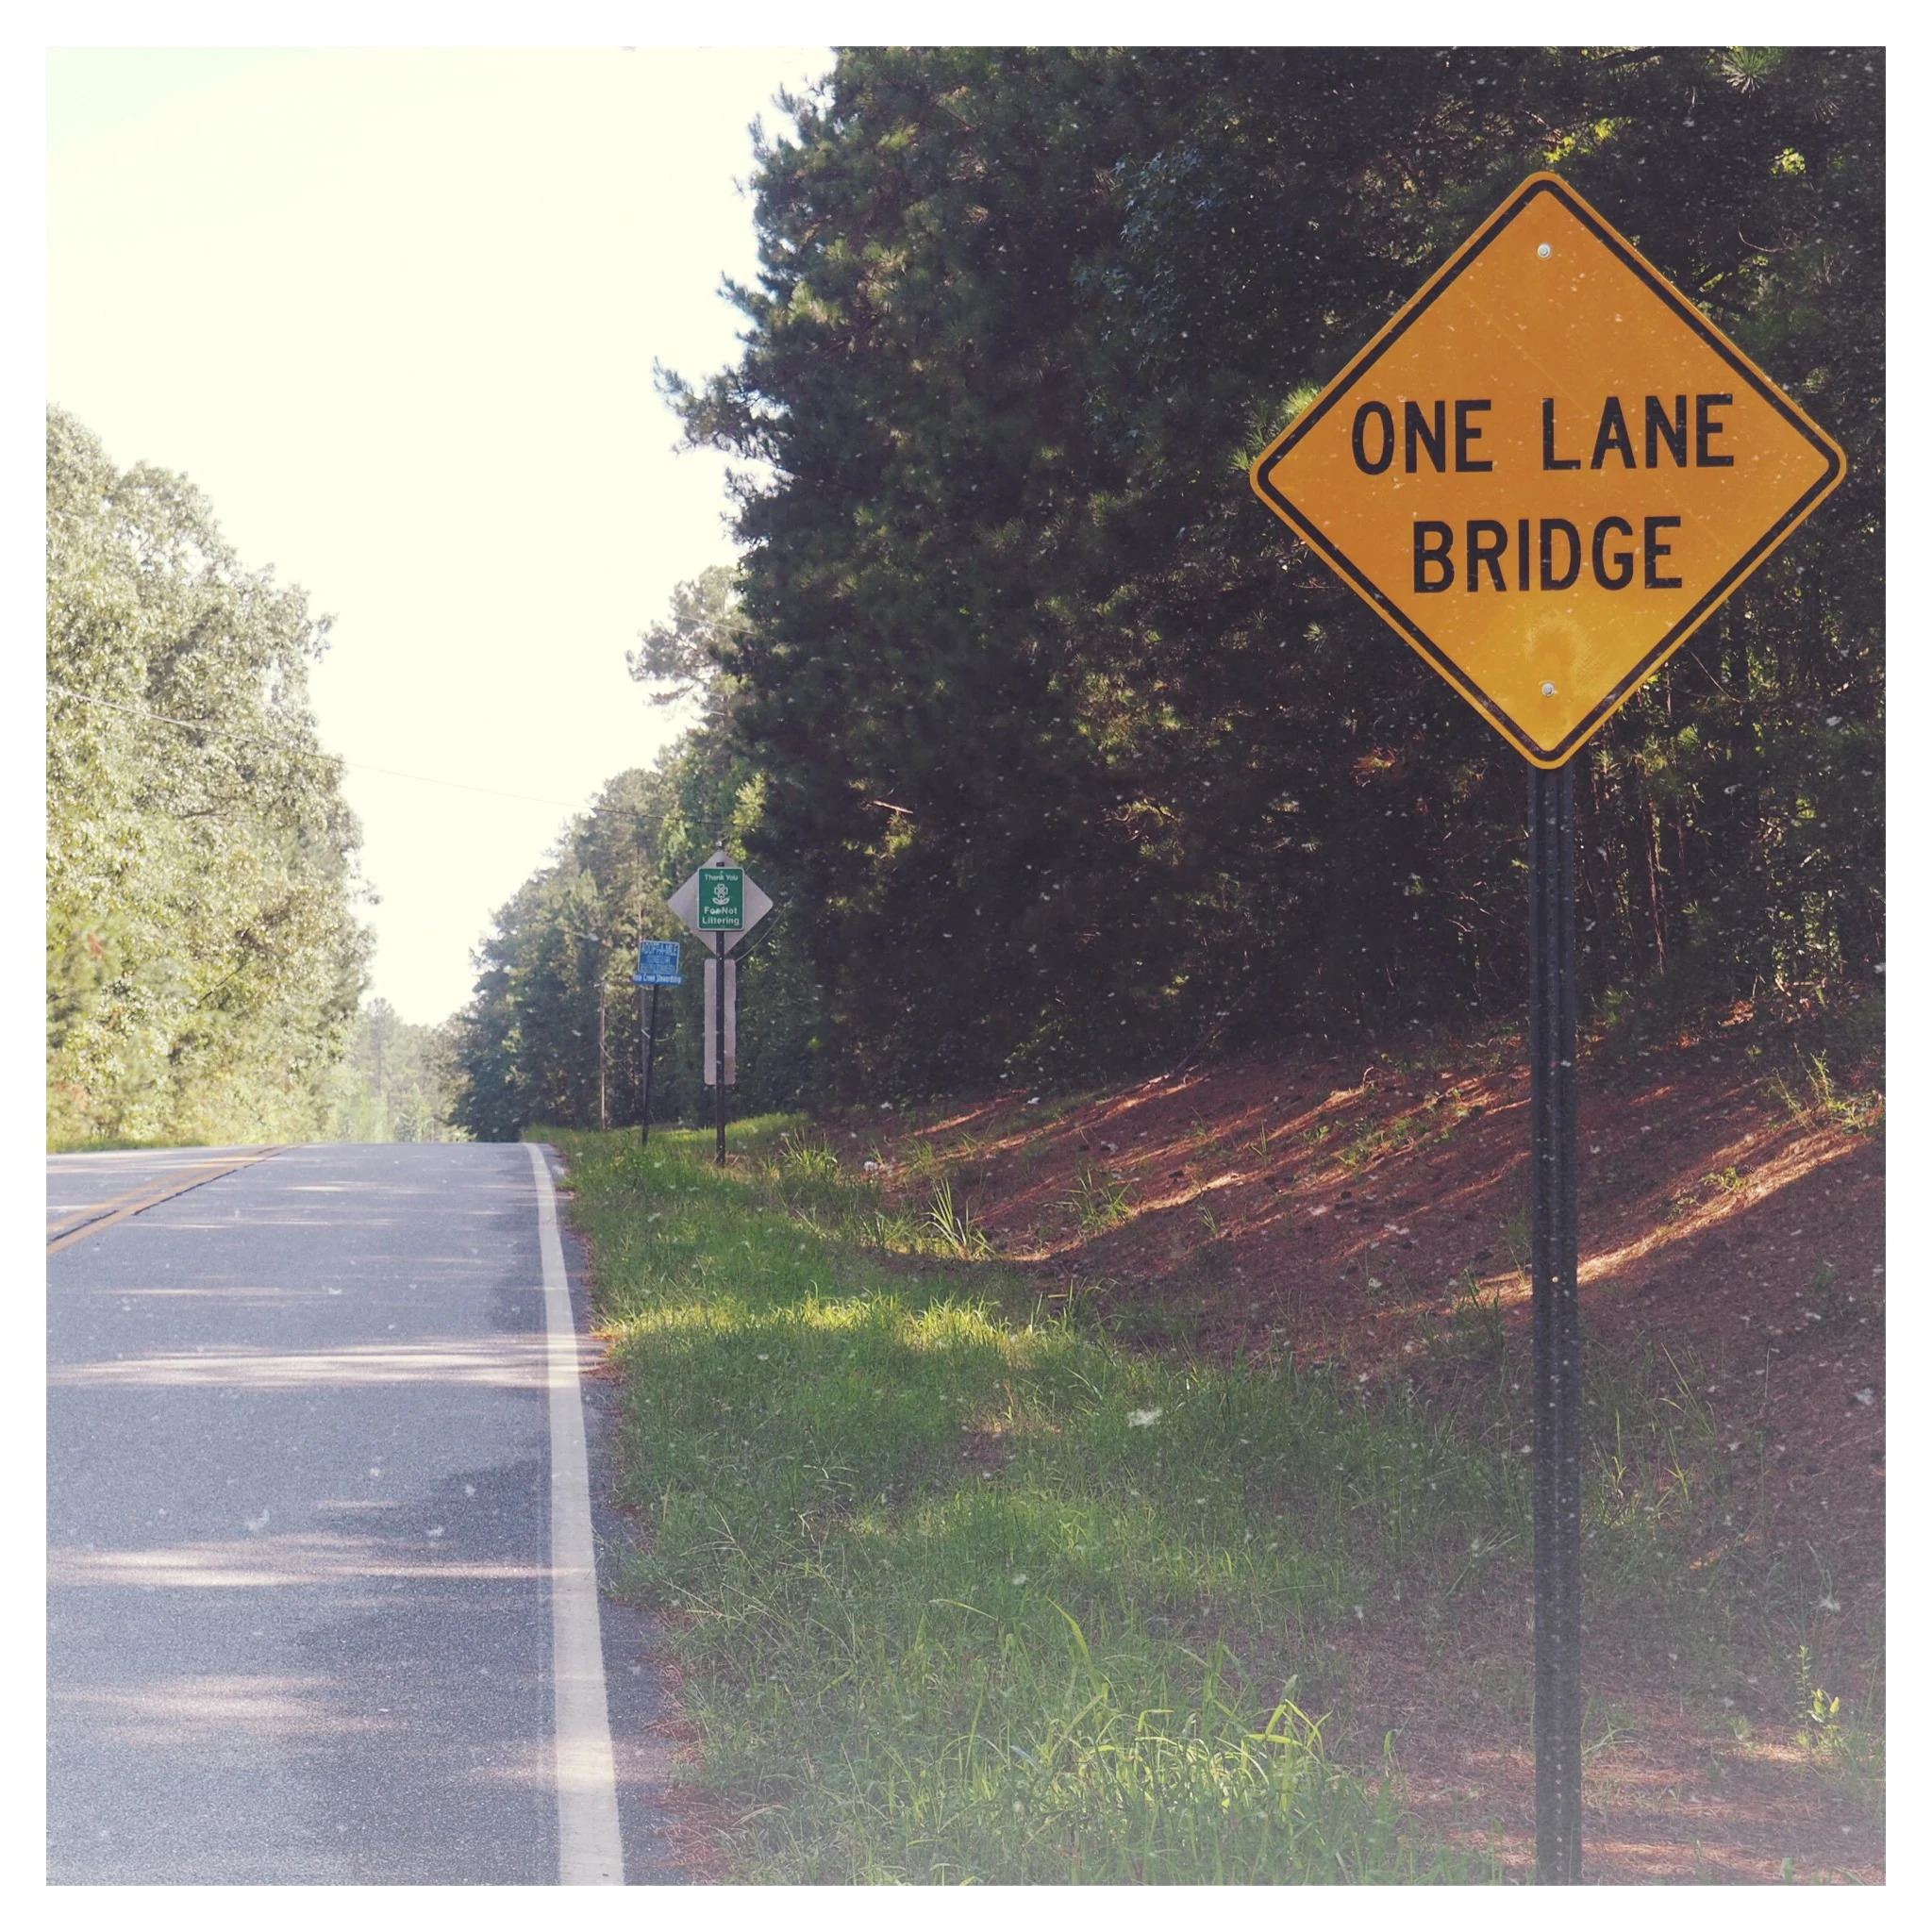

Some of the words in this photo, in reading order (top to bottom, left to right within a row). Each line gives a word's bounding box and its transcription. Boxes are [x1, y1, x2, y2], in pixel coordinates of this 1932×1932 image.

[1352, 400, 1492, 475] ONE
[1543, 394, 1734, 470] LANE
[1414, 516, 1682, 592] BRIDGE
[702, 916, 740, 926] Littering
[704, 906, 721, 915] For
[721, 906, 738, 915] Not
